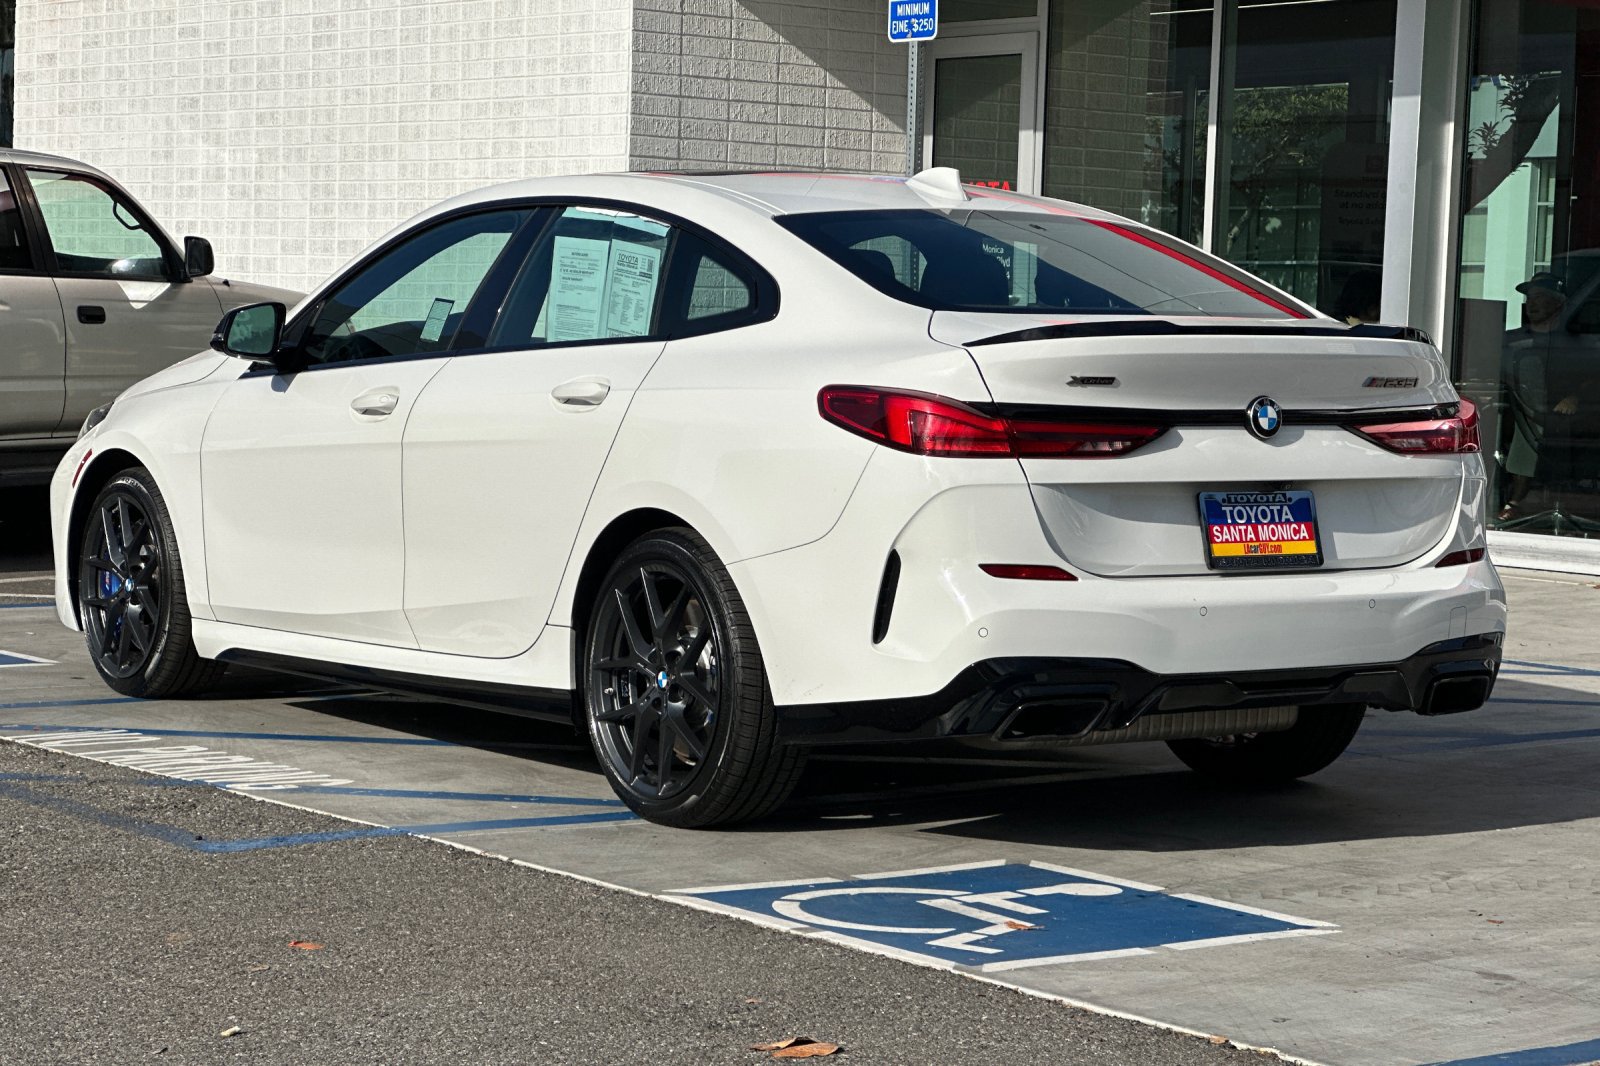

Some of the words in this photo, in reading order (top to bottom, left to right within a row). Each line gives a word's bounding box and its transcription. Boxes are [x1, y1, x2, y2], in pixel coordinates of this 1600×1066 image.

[896, 2, 930, 16] MINIMUM
[912, 18, 934, 32] $250
[982, 243, 1004, 254] Monica
[1227, 494, 1285, 503] TOYOTA
[1222, 505, 1294, 524] TOYOTA
[1212, 525, 1256, 543] SANTA
[1258, 523, 1309, 541] MONICA
[77, 745, 354, 790] PARKING
